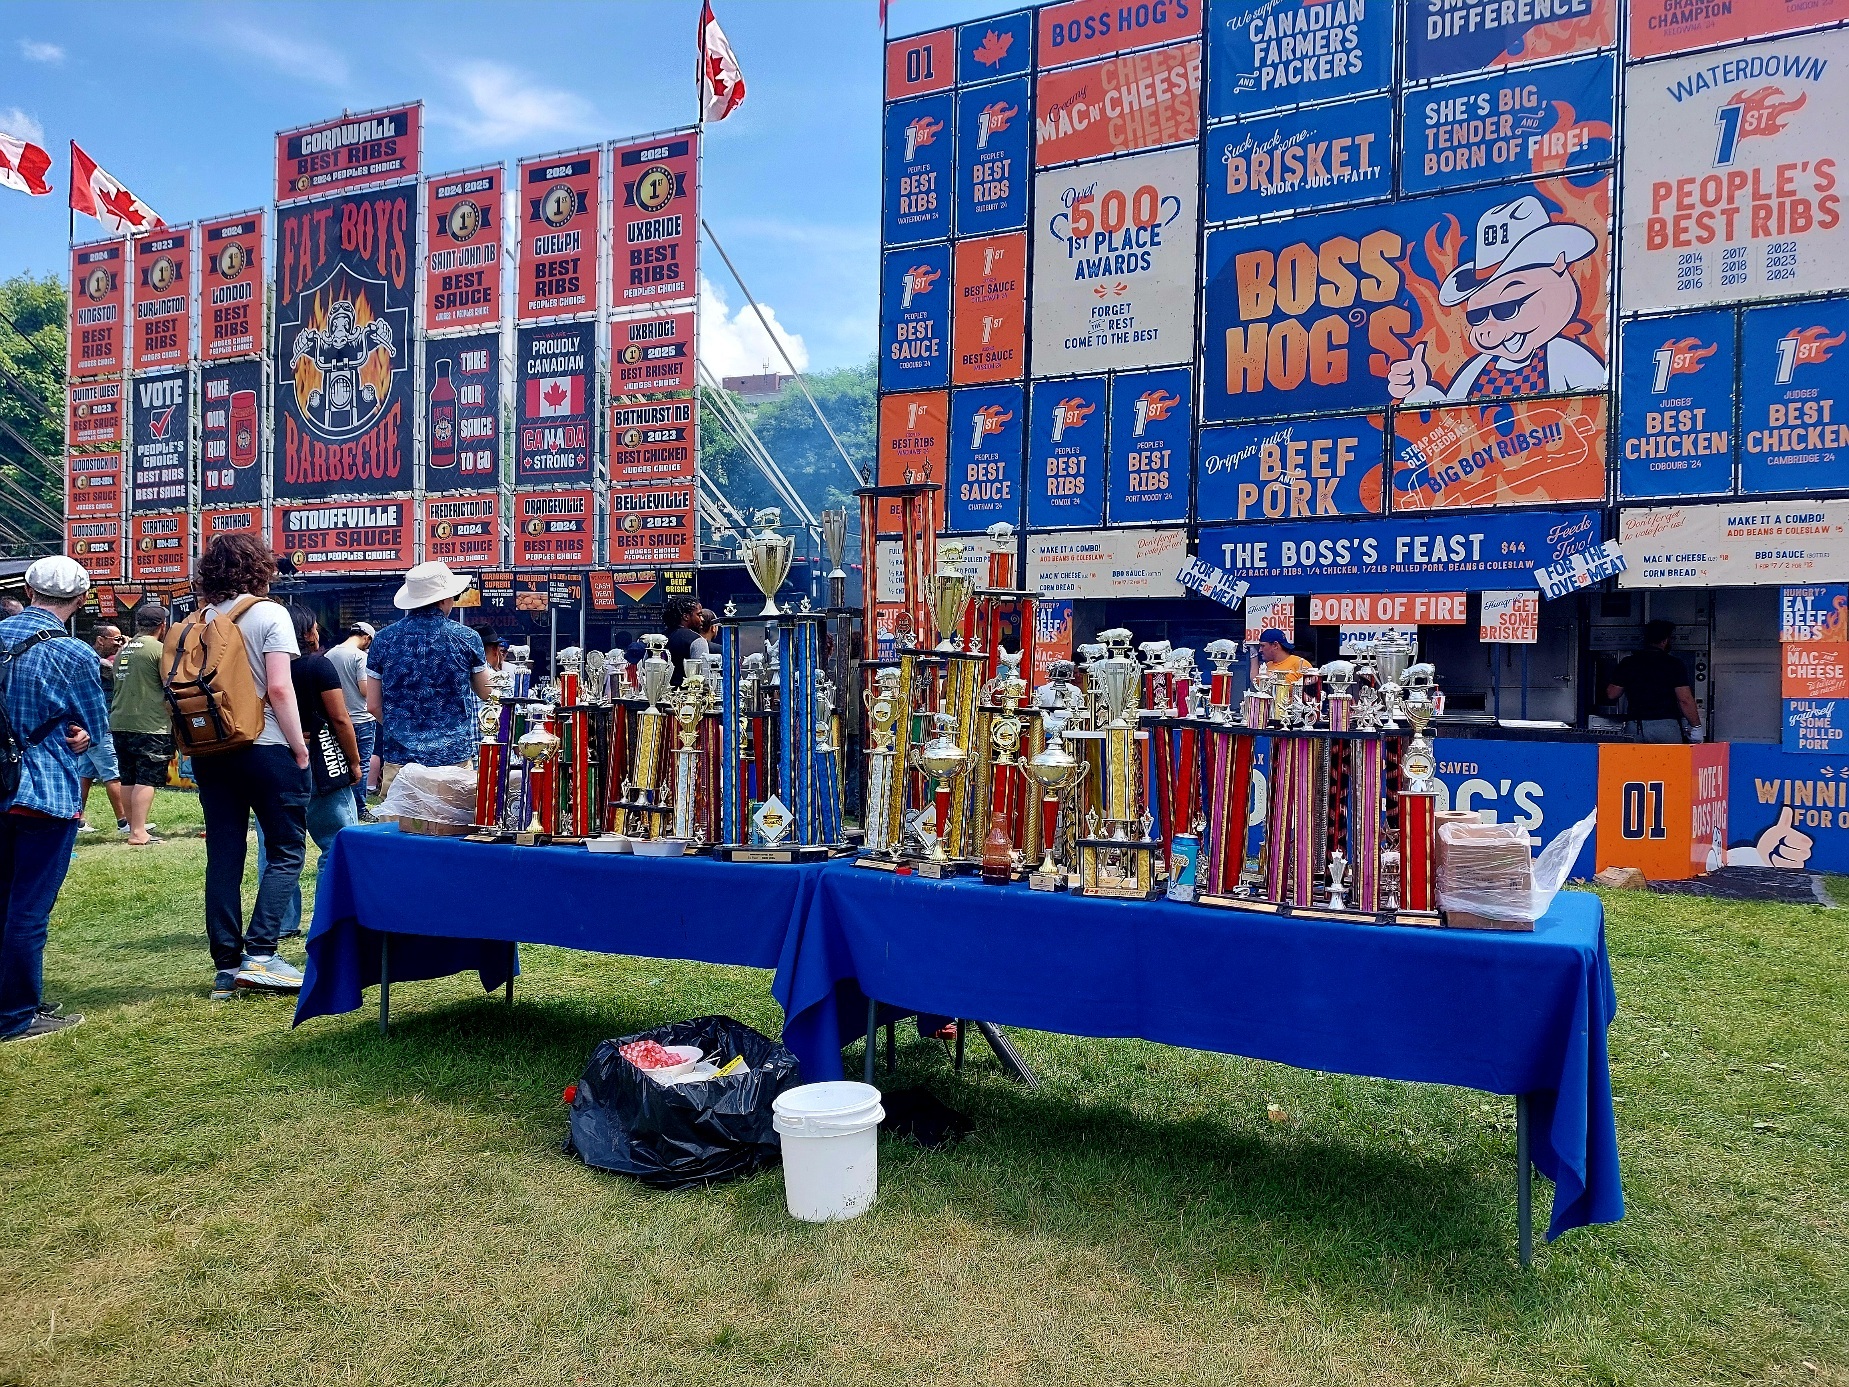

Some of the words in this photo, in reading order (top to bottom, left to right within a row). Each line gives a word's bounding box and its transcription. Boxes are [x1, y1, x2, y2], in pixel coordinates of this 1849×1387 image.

[1052, 14, 1110, 46] BOSS
[1118, 0, 1188, 32] HOG'S
[1249, 0, 1364, 43] CANADIAN
[1428, 0, 1586, 40] DIFFERENCE
[1254, 25, 1358, 67] FARMERS
[906, 44, 934, 83] 01
[1238, 78, 1254, 86] AND
[1261, 50, 1362, 90] PACKERS
[1667, 56, 1828, 103] WATERDOWN
[1037, 102, 1088, 144] MAC
[1089, 103, 1103, 123] N'
[1104, 59, 1200, 117] CHEESE
[1049, 85, 1087, 122] Creamy
[1425, 93, 1490, 125] SHE'S
[1499, 85, 1547, 112] BIG,
[301, 116, 395, 154] CORNWALL
[1426, 117, 1512, 150] TENDER
[1521, 118, 1539, 127] AND
[640, 148, 668, 159] 2025
[1425, 146, 1486, 175] BORN
[1493, 138, 1522, 162] OF
[1528, 127, 1589, 159] FIRE!
[313, 174, 331, 185] 2024
[333, 166, 367, 181] PEOPLES
[369, 160, 401, 175] CHOICE
[546, 166, 572, 177] 2024
[1227, 133, 1374, 194] BRISKET
[438, 185, 464, 197] 2024
[465, 180, 489, 192] 2025
[1061, 182, 1098, 208] Over
[1652, 159, 1836, 215] PEOPLE'S
[1072, 185, 1159, 238] 500
[222, 226, 242, 236] 2024
[1647, 207, 1740, 250] BEST
[1750, 194, 1840, 238] RIBS
[1067, 236, 1088, 258] 1ST
[1095, 224, 1161, 254] PLACE
[1484, 223, 1509, 246] 01
[283, 203, 334, 305] FAT
[340, 197, 407, 289] BOYS
[1679, 253, 1702, 265] 2014
[1723, 247, 1747, 259] 2017
[1767, 242, 1797, 255] 2022
[535, 258, 580, 278] BEST
[1075, 251, 1150, 280] AWARDS
[1235, 229, 1402, 321] BOSS
[1678, 266, 1703, 278] 2015
[1722, 261, 1747, 272] 2018
[1767, 255, 1796, 267] 2023
[442, 271, 484, 291] BEST
[535, 277, 580, 296] RIBS
[624, 286, 655, 298] PEOPLES
[658, 281, 684, 294] CHOICE
[1677, 278, 1703, 291] 2016
[1721, 274, 1747, 285] 2019
[1767, 269, 1795, 281] 2024
[434, 287, 491, 309] SAUCE
[529, 298, 558, 309] PEOPLES
[560, 295, 585, 307] CHOICE
[1091, 303, 1131, 317] FORGET
[629, 319, 675, 343] UXBRIDGE
[1108, 317, 1134, 330] REST
[532, 337, 580, 355] PROUDLY
[891, 339, 939, 359] SAUCE
[1064, 337, 1093, 349] COME
[1097, 335, 1109, 345] TO
[1111, 332, 1130, 343] THE
[1133, 329, 1158, 341] BEST
[647, 348, 675, 358] 2025
[527, 355, 584, 374] CANADIAN
[620, 367, 642, 380] BEST
[645, 362, 683, 378] BRISKET
[284, 398, 401, 484] BARBECUE
[647, 431, 676, 441] 2023
[892, 439, 911, 448] BEST
[913, 437, 934, 447] RIBS
[1626, 432, 1727, 460] CHICKEN
[1748, 424, 1849, 454] CHICKEN
[142, 454, 179, 467] CHOICE
[534, 453, 575, 469] STRONG
[617, 452, 641, 465] BEST
[643, 447, 688, 462] CHICKEN
[1260, 438, 1358, 481] BEEF
[1428, 464, 1461, 494] BIG
[1459, 445, 1496, 476] BOY
[1496, 421, 1562, 458] RIBS!!!
[1768, 454, 1820, 465] CAMBRIDGE
[1821, 453, 1835, 462] '24
[137, 470, 159, 483] BEST
[163, 468, 184, 481] RIBS
[136, 488, 157, 501] BEST
[159, 485, 186, 499] SAUCE
[614, 491, 689, 511] BELLEVILLE
[1238, 477, 1340, 520] PORK
[289, 506, 397, 529] STOUFFVILLE
[647, 517, 676, 527] 2023
[1727, 516, 1757, 526] MAKE
[1760, 516, 1771, 525] IT
[1774, 516, 1781, 525] A
[1785, 514, 1825, 524] COMBO!
[285, 533, 330, 549] BEST
[335, 529, 401, 546] SAUCE
[524, 541, 551, 552] BEST
[557, 539, 583, 550] RIBS
[618, 535, 645, 547] BEST
[649, 533, 686, 546] SAUCE
[1552, 530, 1592, 561] Two!
[1222, 543, 1267, 569] THE
[1282, 538, 1379, 565] BOSS'S
[1395, 534, 1484, 563] FEAST
[1502, 541, 1526, 555] $44
[1643, 569, 1666, 577] CORN
[1667, 568, 1697, 576] BREAD
[1271, 604, 1295, 617] GET
[1311, 599, 1374, 621] BORN
[1382, 598, 1406, 620] OF
[1415, 596, 1467, 620] FIRE
[1511, 600, 1538, 613] GET
[1783, 597, 1814, 611] EAT
[1261, 615, 1295, 629] SOME
[1500, 613, 1538, 626] SOME
[1783, 611, 1827, 625] BEEF
[1481, 626, 1538, 640] BRISKET
[1783, 626, 1823, 641] RIBS
[1788, 652, 1819, 664] MAC
[1787, 665, 1843, 679] CHEESE
[1790, 702, 1816, 711] PULL
[1800, 718, 1831, 727] SOME
[1800, 729, 1843, 739] PULLED
[318, 729, 340, 777] ONTARIO
[1799, 740, 1828, 750] PORK
[1439, 761, 1478, 775] SAVED
[1622, 781, 1666, 840] 01
[1794, 809, 1833, 828] FOR
